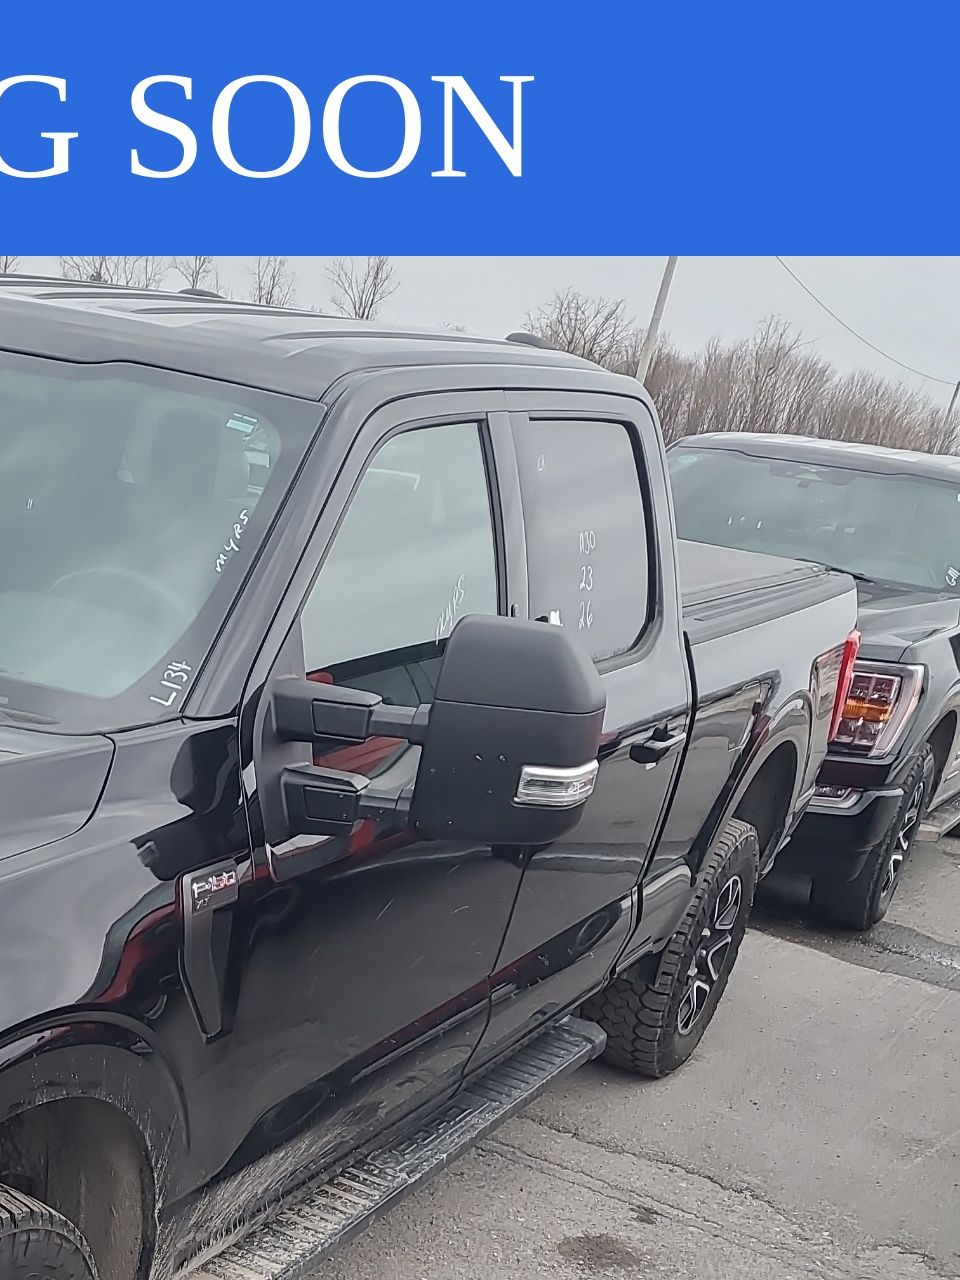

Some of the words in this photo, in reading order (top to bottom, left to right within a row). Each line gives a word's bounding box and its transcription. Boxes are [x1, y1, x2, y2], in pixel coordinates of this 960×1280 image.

[579, 565, 594, 591] 23
[578, 600, 593, 630] 26
[149, 660, 192, 707] L134
